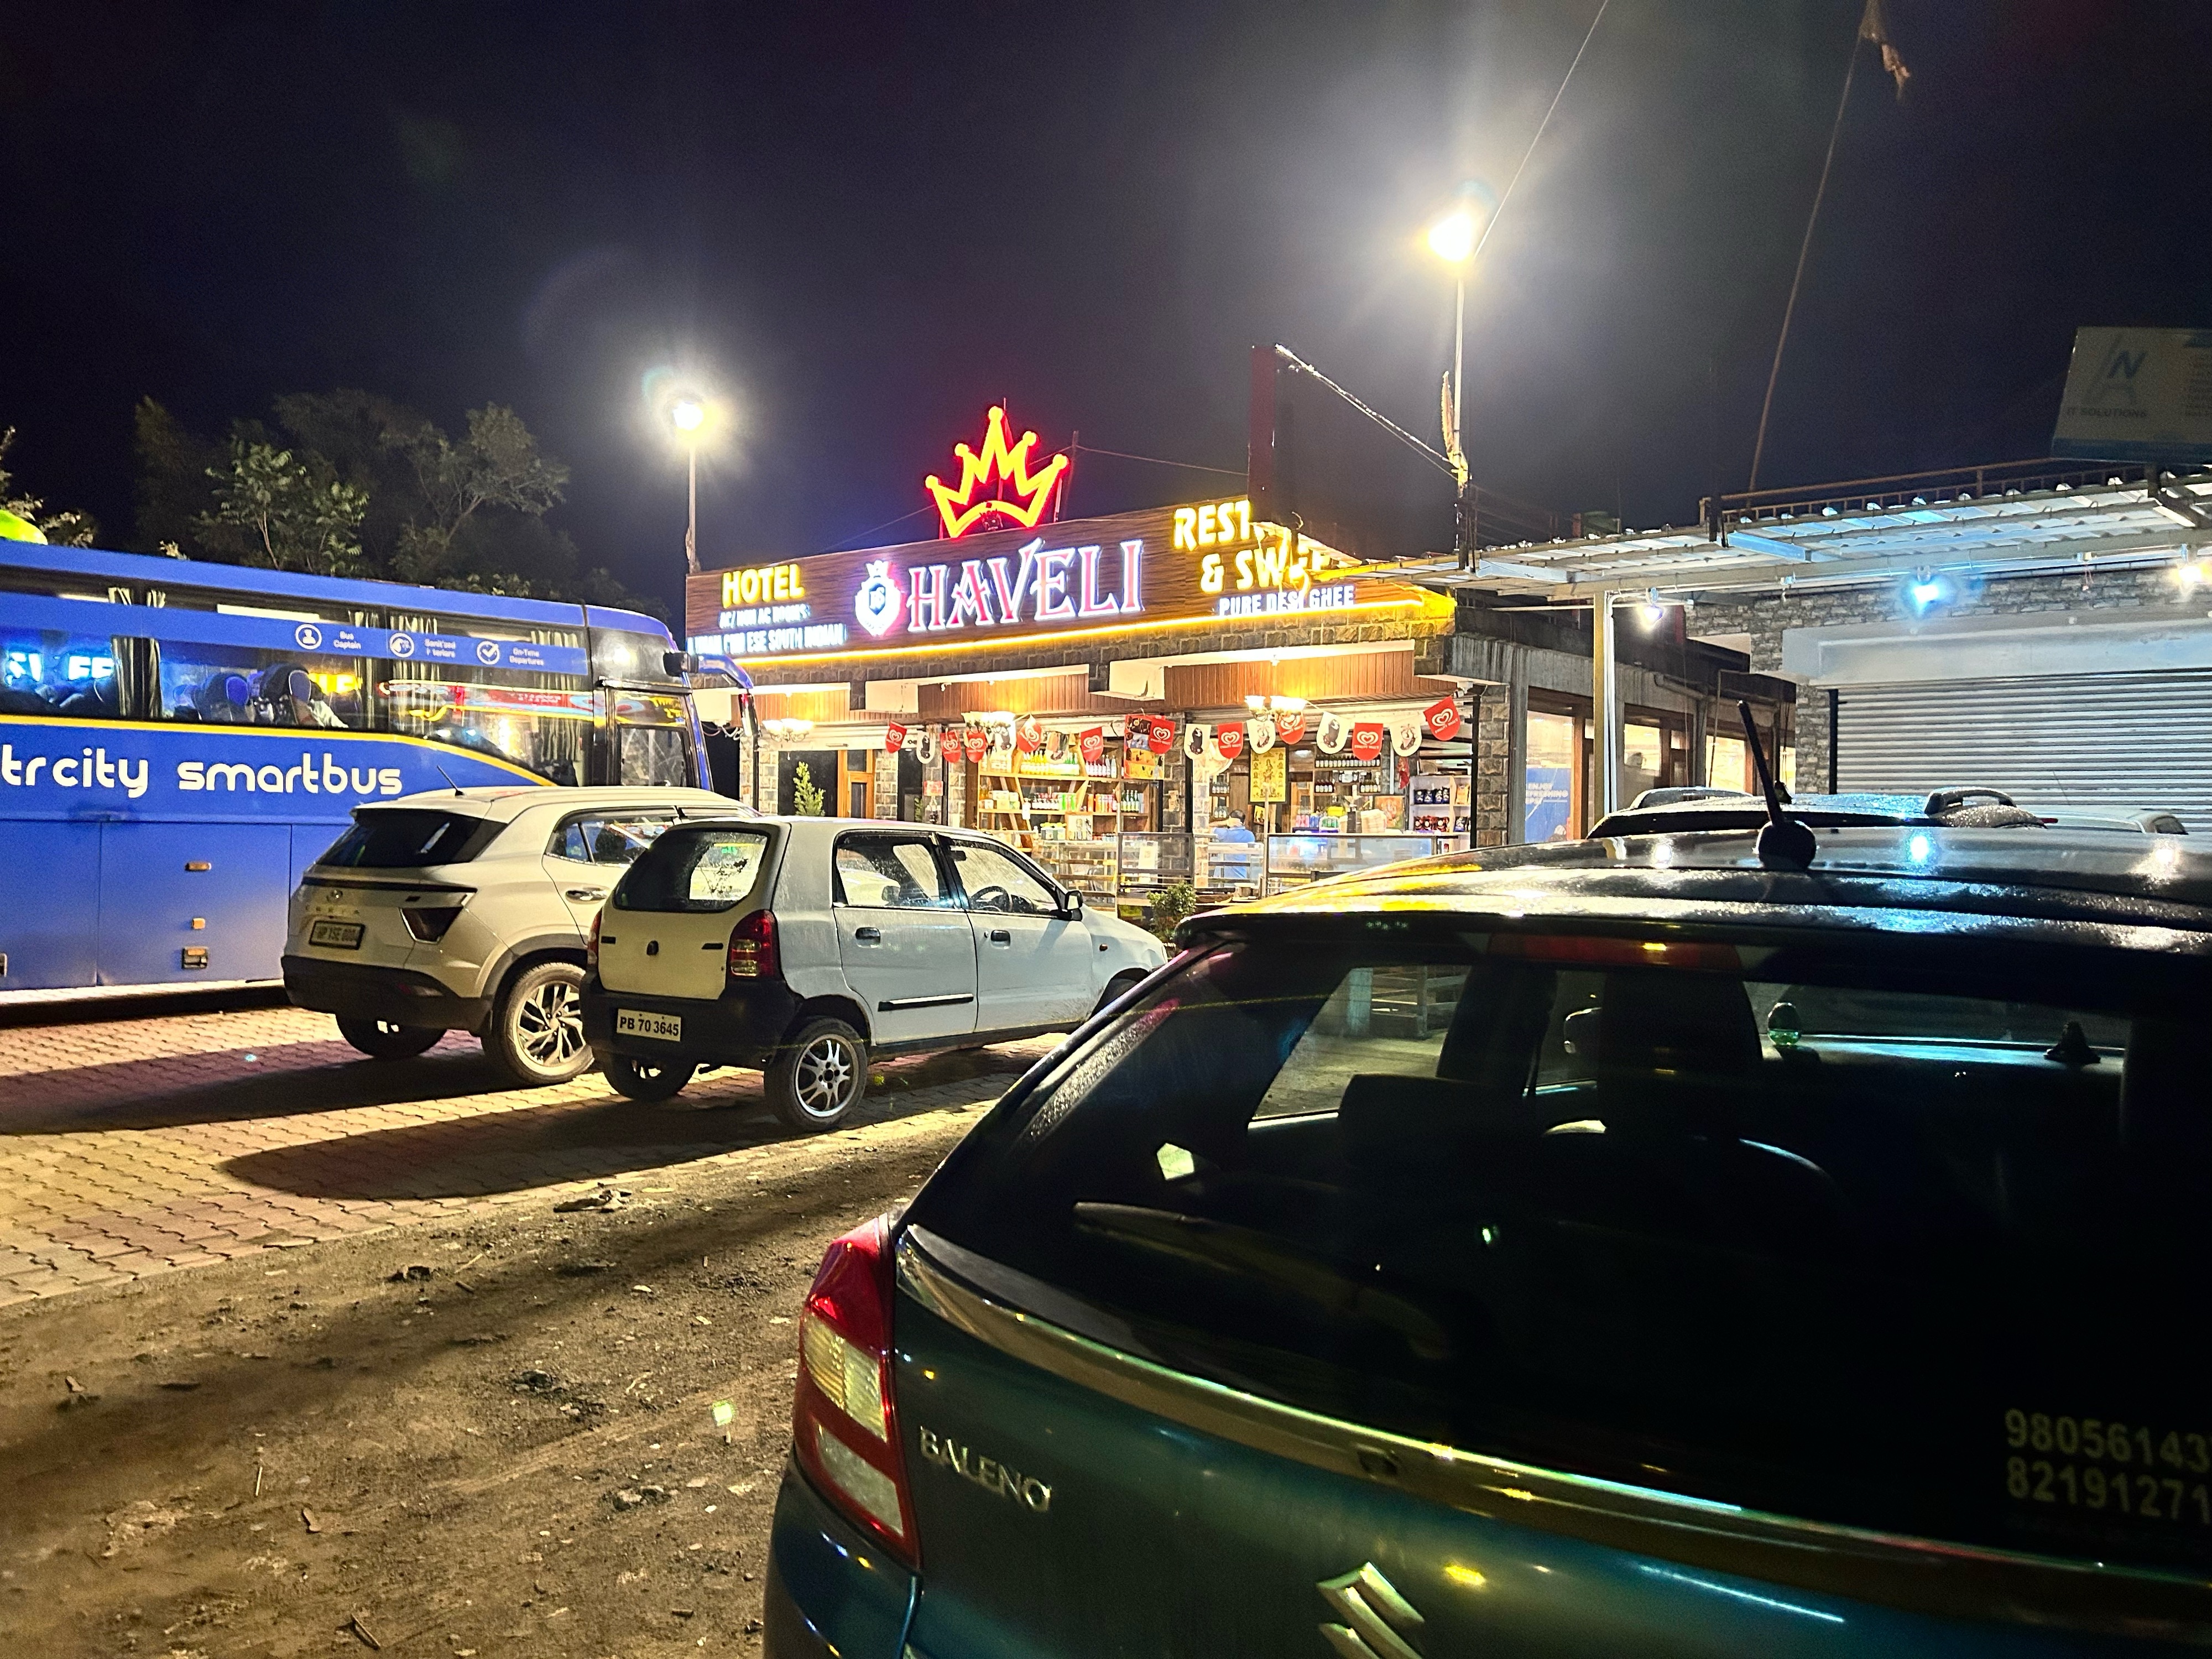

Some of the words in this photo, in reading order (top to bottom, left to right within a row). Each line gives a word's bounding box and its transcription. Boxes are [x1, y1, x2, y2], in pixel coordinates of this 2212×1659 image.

[722, 564, 805, 608] HOTEL
[906, 537, 1145, 632] HAVELI
[1200, 553, 1224, 592] &
[1219, 596, 1262, 615] PURE
[1309, 585, 1354, 609] GHEE
[768, 627, 803, 651] SOUTH
[1, 744, 148, 798] trcity
[178, 753, 403, 795] smartbus
[620, 1016, 635, 1030] PB
[638, 1019, 651, 1032] 70
[653, 1021, 679, 1036] 3645
[2004, 1407, 2212, 1473] 98056143
[920, 1426, 1052, 1513] BALENO
